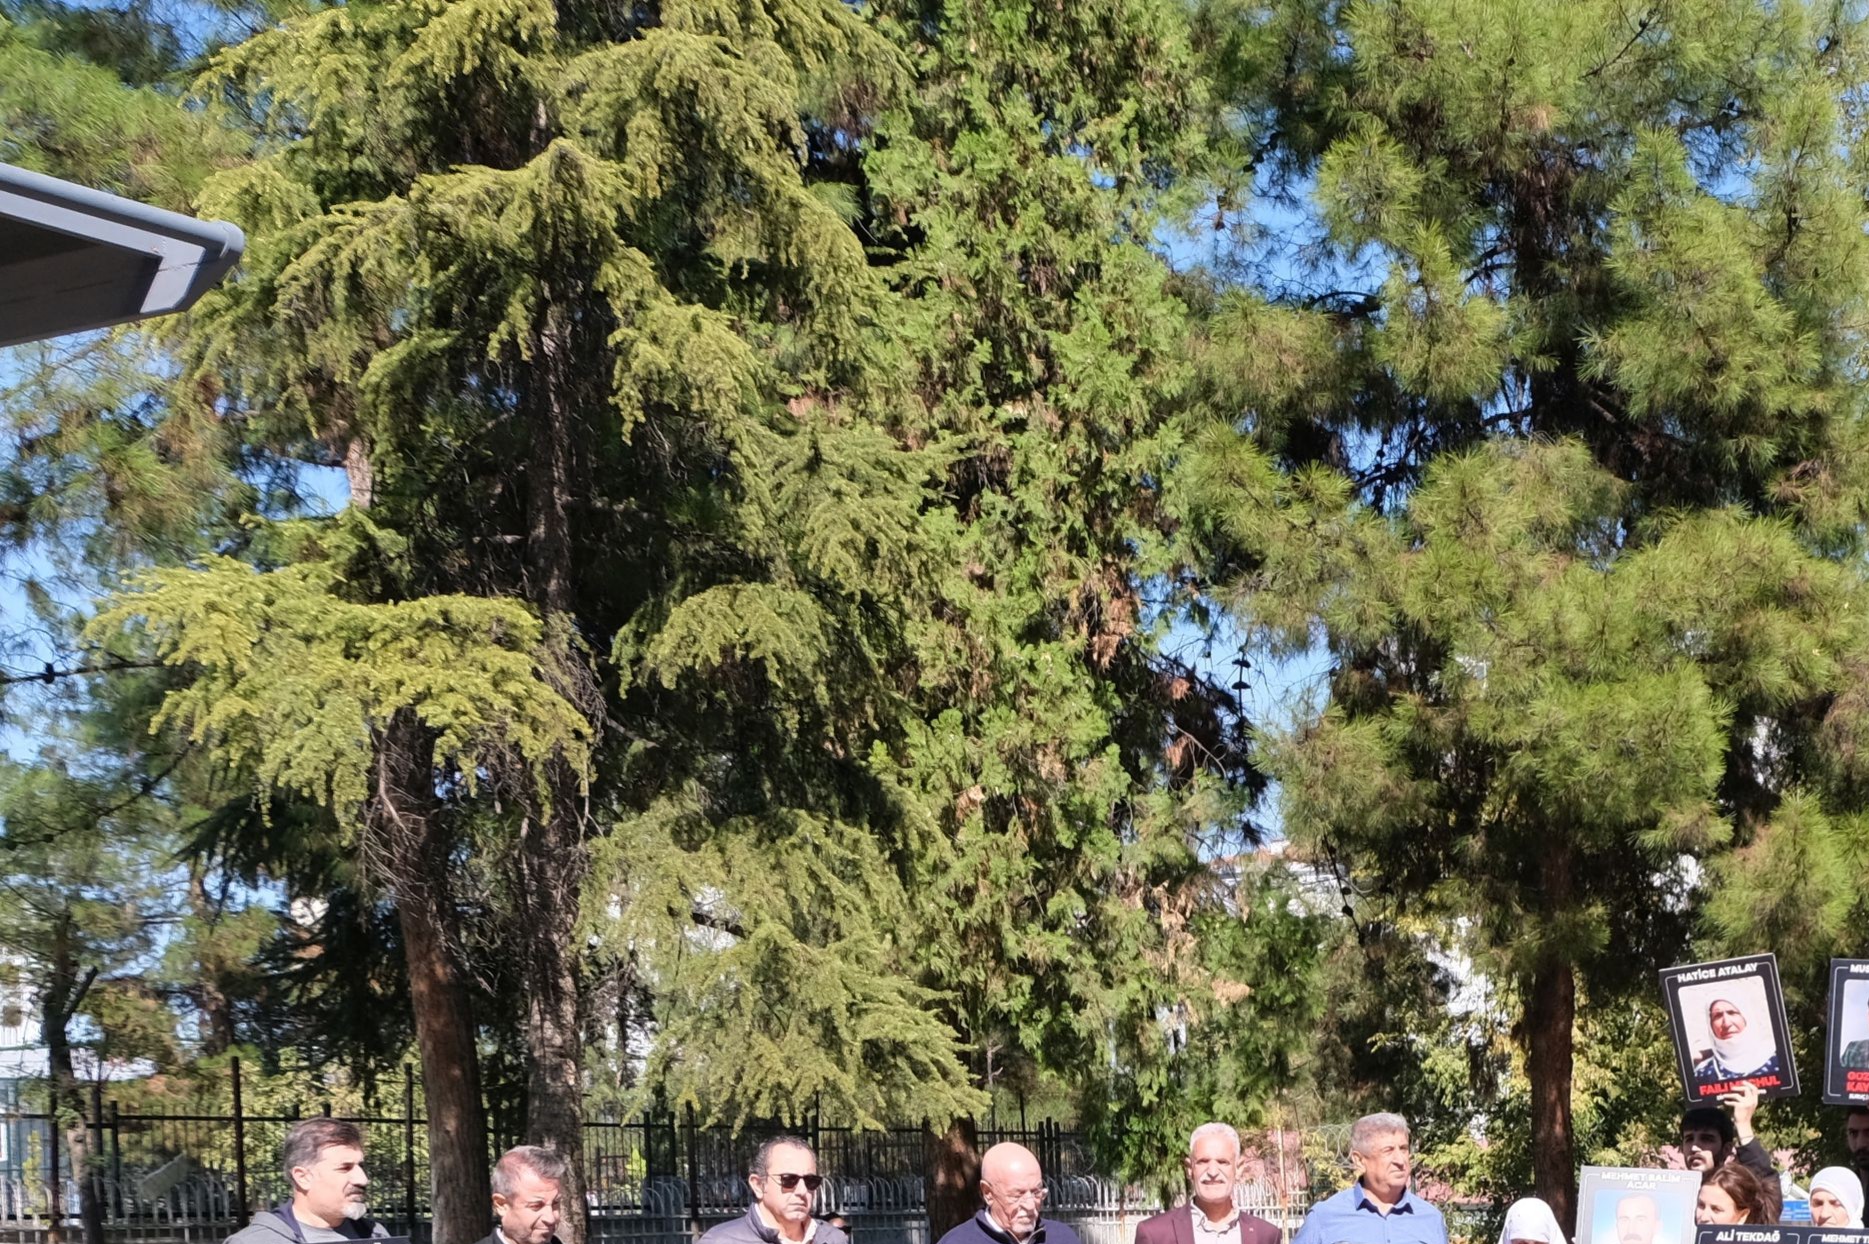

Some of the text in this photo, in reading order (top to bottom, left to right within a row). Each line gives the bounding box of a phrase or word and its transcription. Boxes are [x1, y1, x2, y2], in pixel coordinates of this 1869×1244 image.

[1677, 961, 1759, 983] HATİCE ATALAY
[1601, 1171, 1681, 1183] MEHMET SALİM
[1626, 1180, 1656, 1190] ACAR
[1715, 1228, 1781, 1243] ALİ TEKDAĞ
[1821, 1234, 1861, 1244] MEHMET
